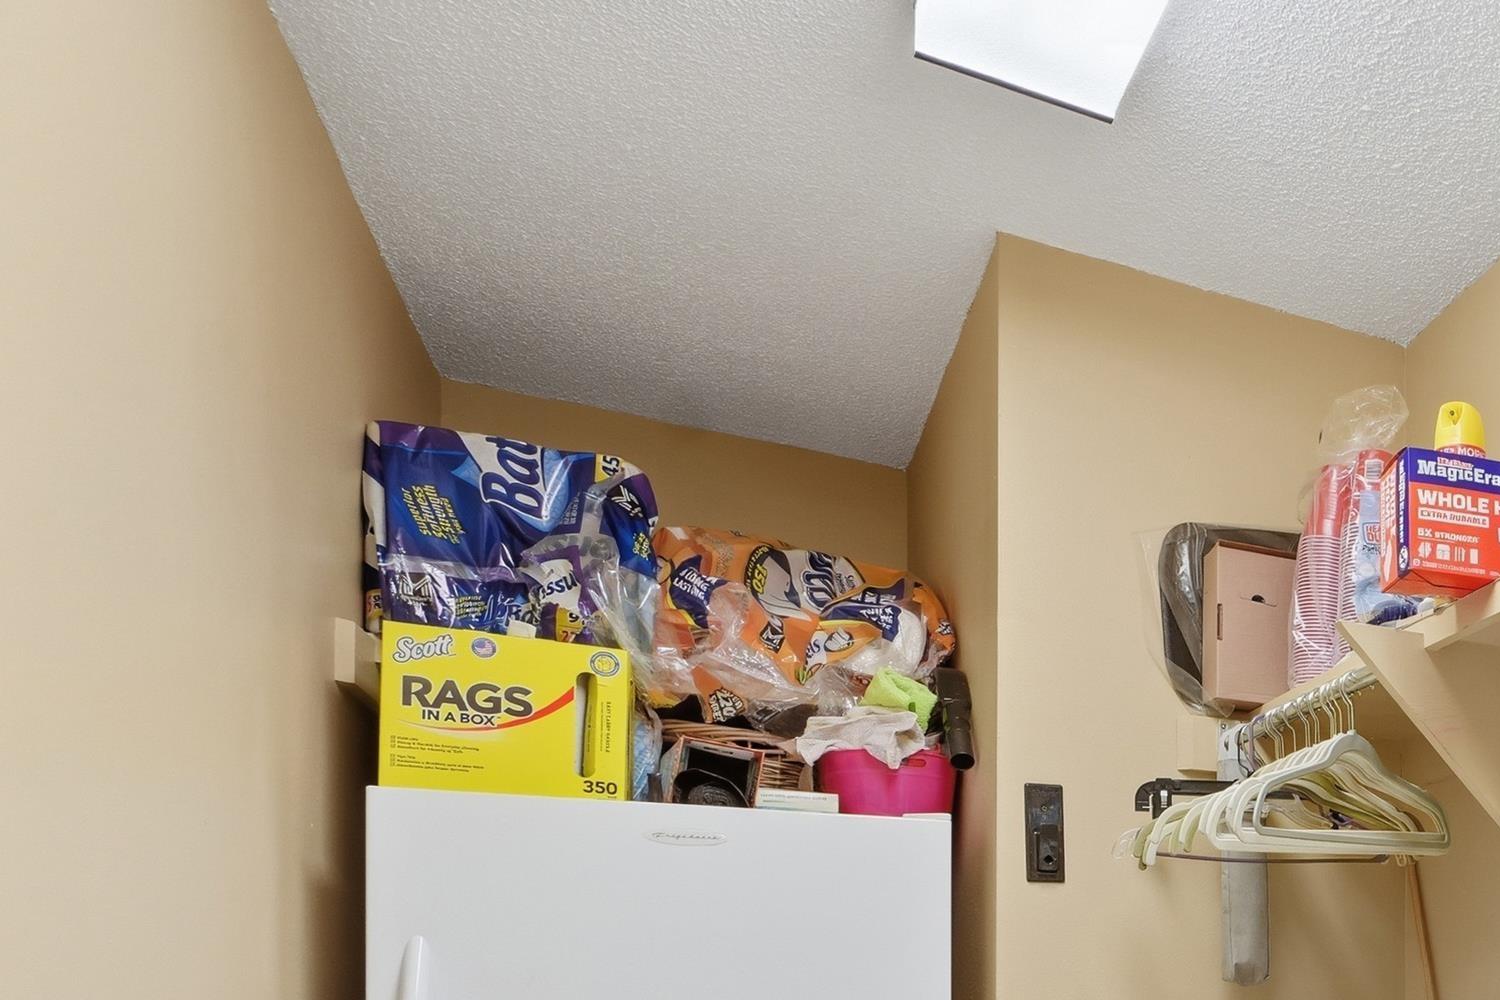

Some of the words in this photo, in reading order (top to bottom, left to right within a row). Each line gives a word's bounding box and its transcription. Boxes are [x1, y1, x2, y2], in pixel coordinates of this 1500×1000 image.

[1416, 488, 1490, 514] WHOLE
[392, 633, 456, 664] Scott
[402, 675, 534, 718] RAGS
[421, 708, 440, 721] IN
[445, 711, 458, 723] A
[459, 713, 497, 727] BOX
[583, 780, 618, 796] 350
